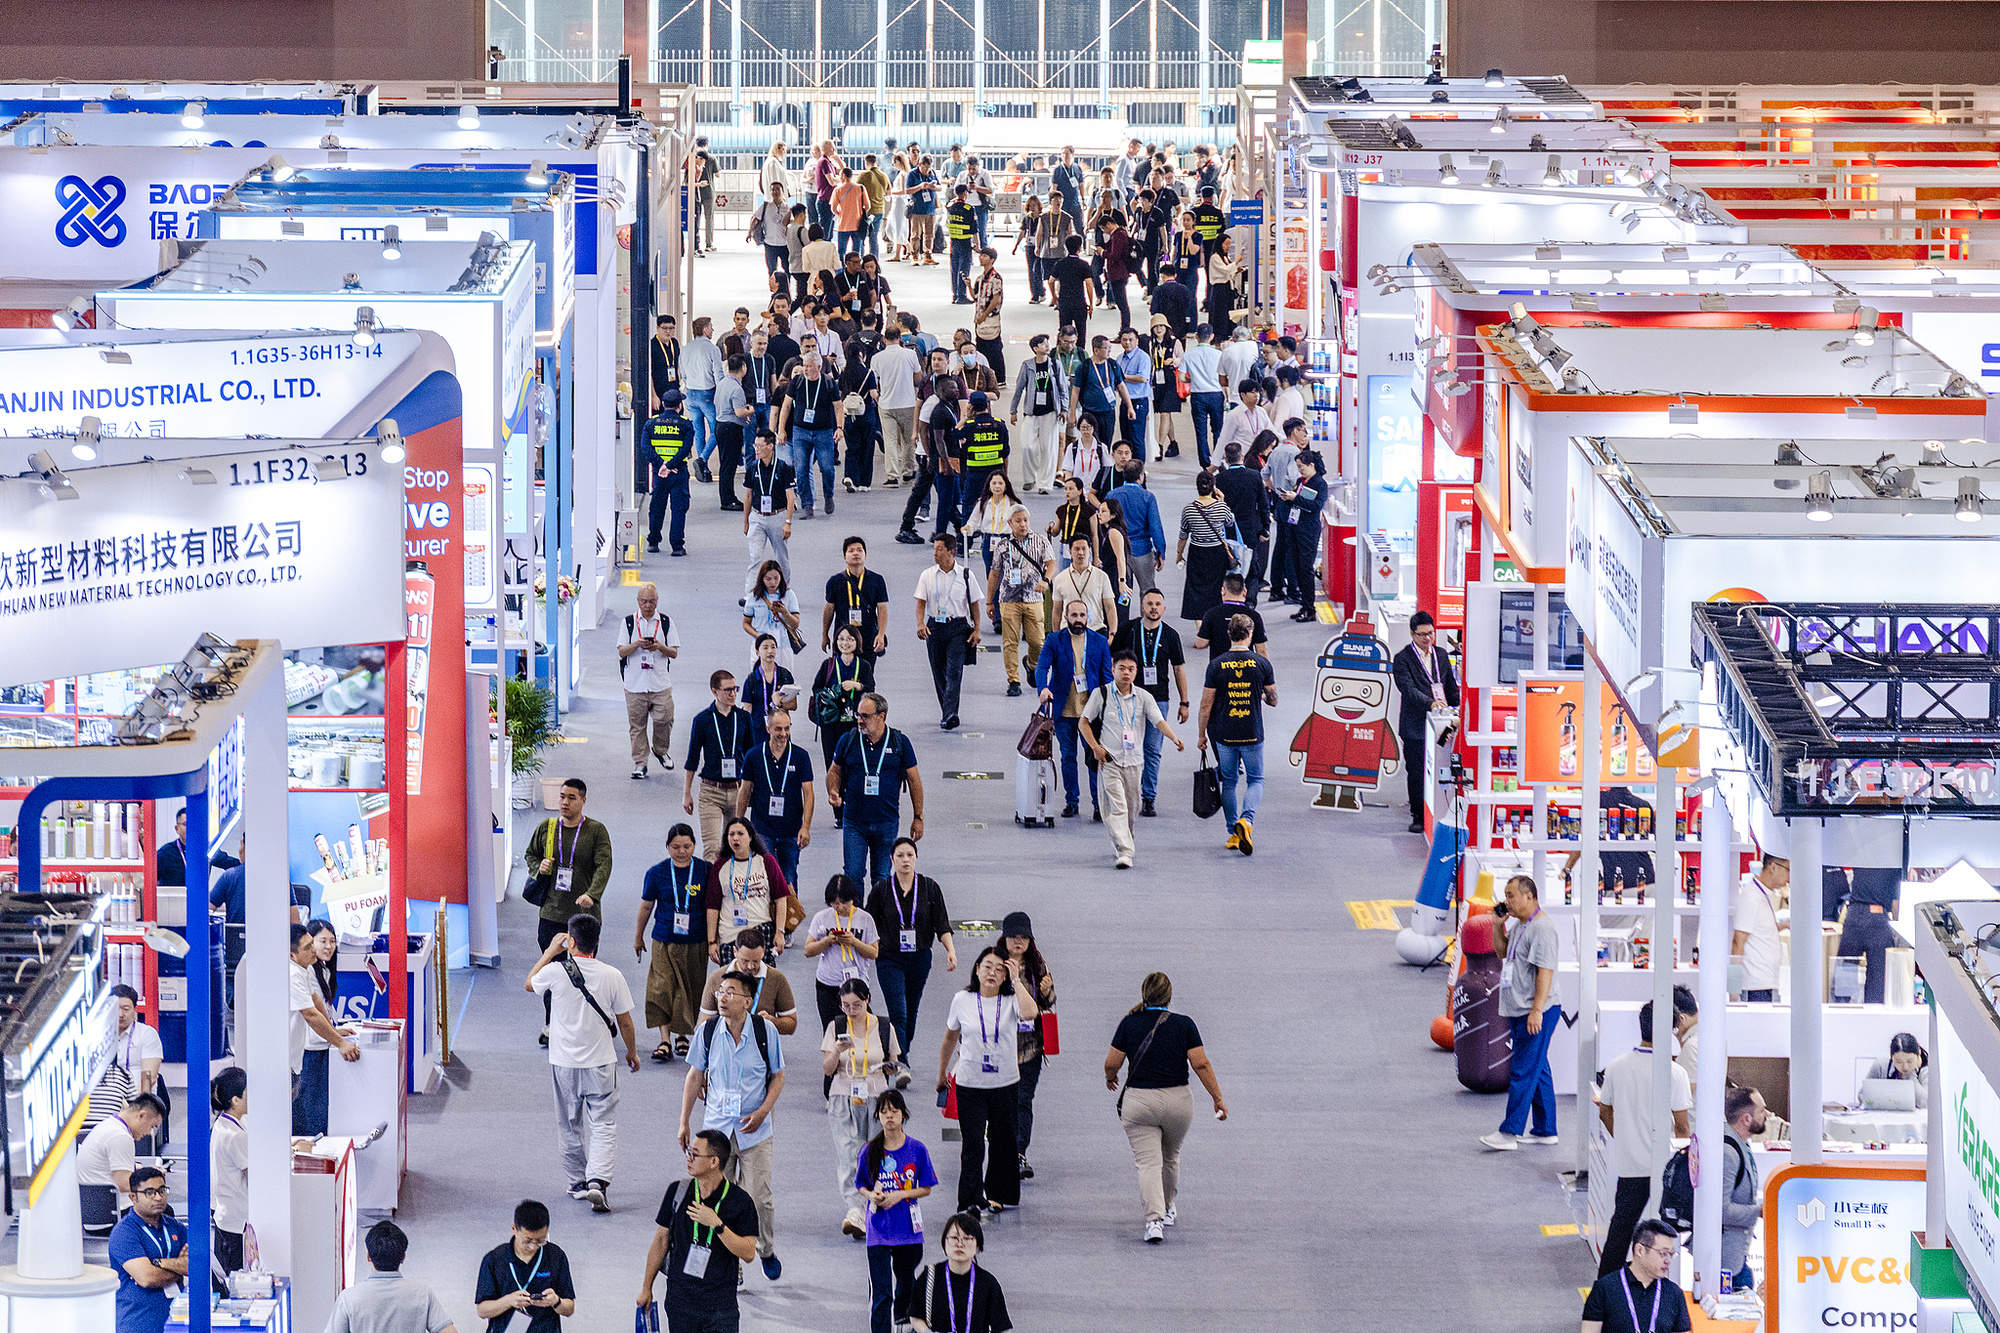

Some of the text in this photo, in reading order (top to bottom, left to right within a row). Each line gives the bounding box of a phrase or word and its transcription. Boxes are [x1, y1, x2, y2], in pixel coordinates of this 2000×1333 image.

[230, 342, 383, 366] 1.1G35-36H13-14
[72, 382, 212, 411] INDUSTRIAL
[219, 379, 266, 406] CO.,
[272, 377, 322, 400] LTD.
[39, 590, 67, 611] NEW
[70, 580, 133, 606] MATERIAL
[136, 571, 234, 597] TECHNOLOGY
[1833, 1219, 1862, 1229] Small
